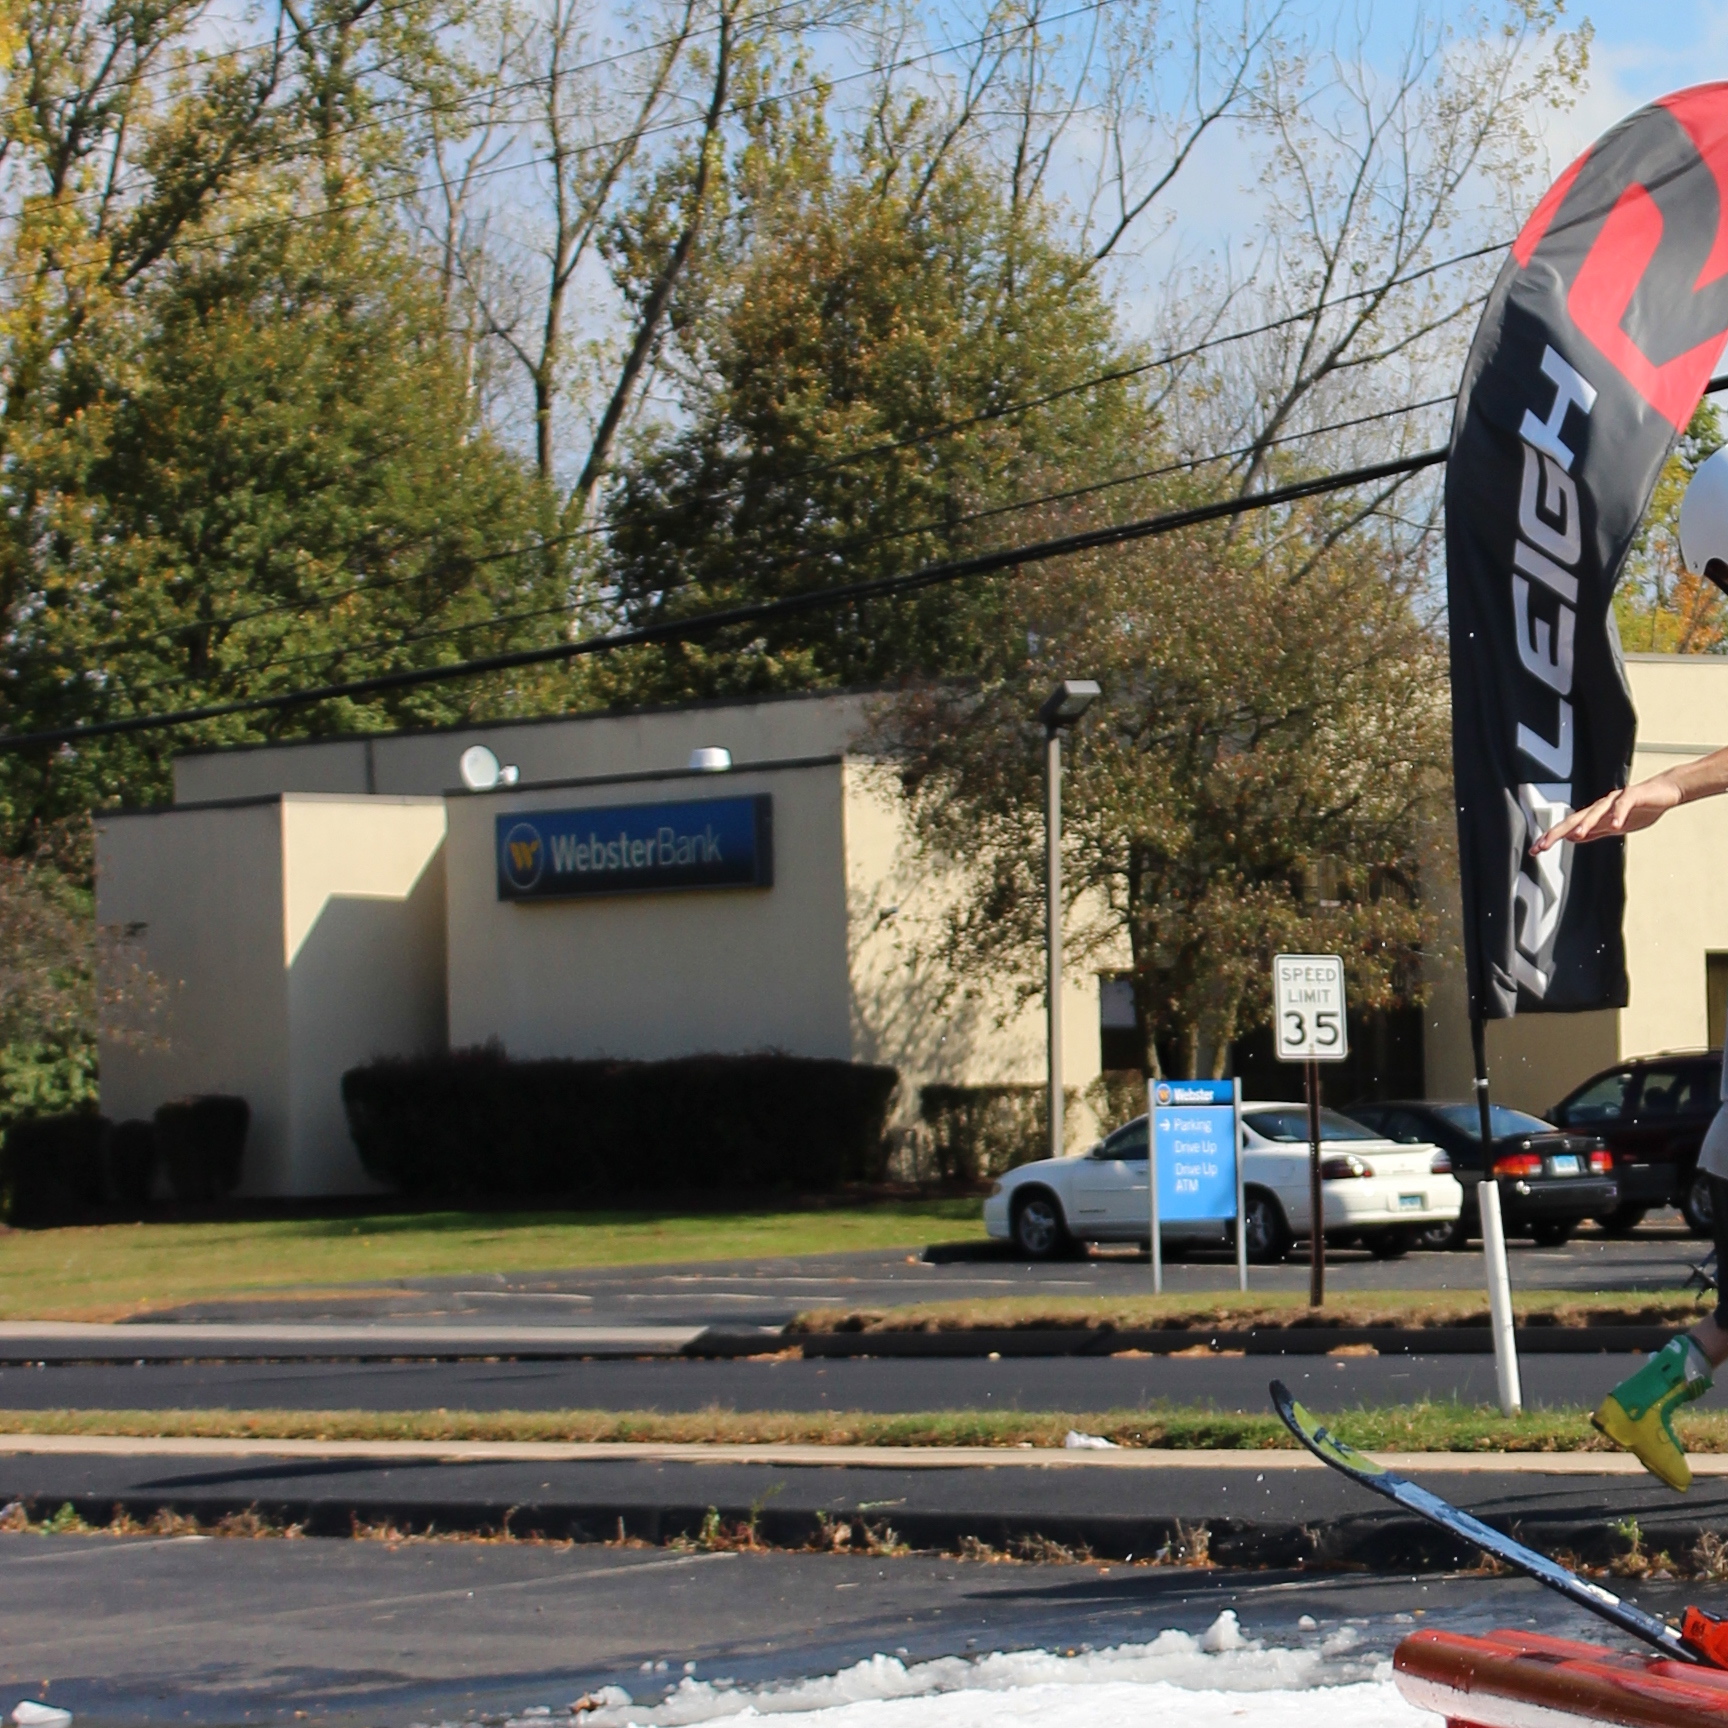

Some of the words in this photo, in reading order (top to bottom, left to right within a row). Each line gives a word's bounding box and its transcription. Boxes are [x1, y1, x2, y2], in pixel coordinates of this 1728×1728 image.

[1511, 343, 1598, 1001] RALEIGH
[1281, 966, 1337, 983] SPEED
[1287, 988, 1332, 1003] LIMIT
[1283, 1010, 1340, 1047] 35
[1172, 1086, 1215, 1102] Webster
[1173, 1117, 1213, 1133] Parking
[1174, 1139, 1201, 1154] Drive
[1202, 1140, 1218, 1155] Up
[1174, 1162, 1201, 1176] Drive
[1203, 1162, 1218, 1177] Up
[1175, 1177, 1199, 1192] ATM
